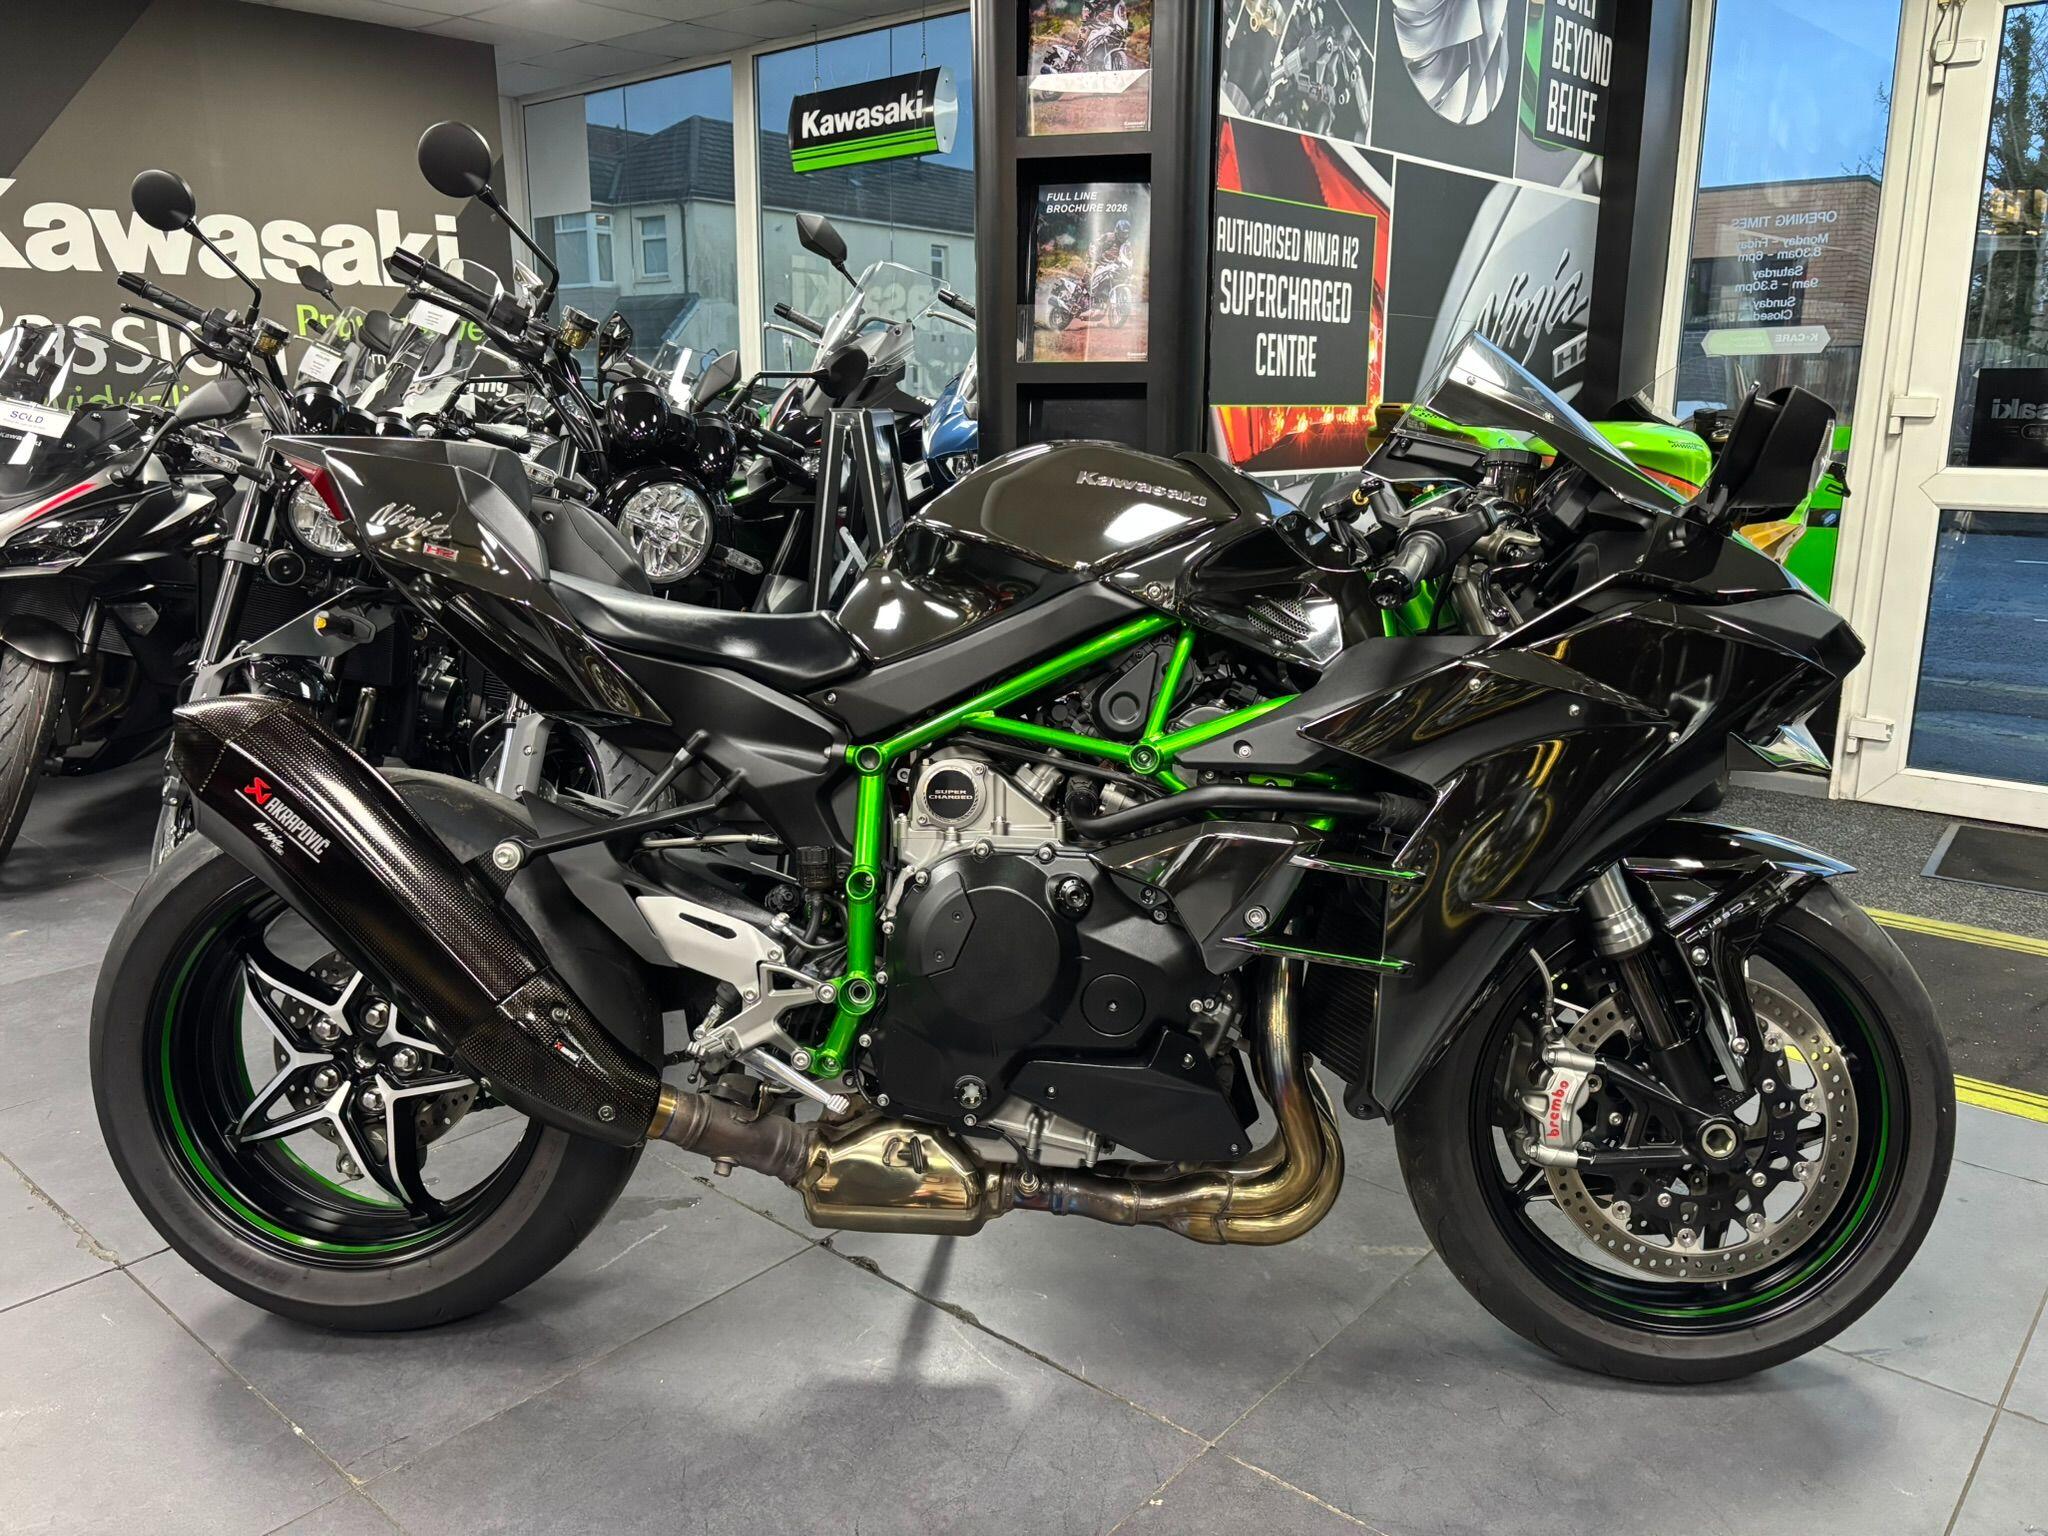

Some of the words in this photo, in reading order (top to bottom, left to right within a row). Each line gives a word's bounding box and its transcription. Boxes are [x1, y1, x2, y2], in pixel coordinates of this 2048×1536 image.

[1551, 15, 1613, 87] BEYOND
[802, 90, 924, 139] Kawasaki
[1546, 79, 1598, 142] BELIEF
[1046, 192, 1072, 202] FULL
[1074, 191, 1098, 201] LINE
[1046, 203, 1103, 214] BROCHURE
[1105, 203, 1128, 213] 2026
[1216, 216, 1301, 262] AUTHORISED
[1303, 229, 1340, 267] NINJA
[1342, 236, 1361, 269] H2
[1220, 268, 1353, 324] SUPERCHARGED
[1255, 332, 1318, 378] CENTRE
[9, 410, 44, 424] SOLD
[1076, 470, 1207, 507] Kawasaki
[369, 502, 452, 550] Ninja
[1547, 1080, 1569, 1137] brembo
